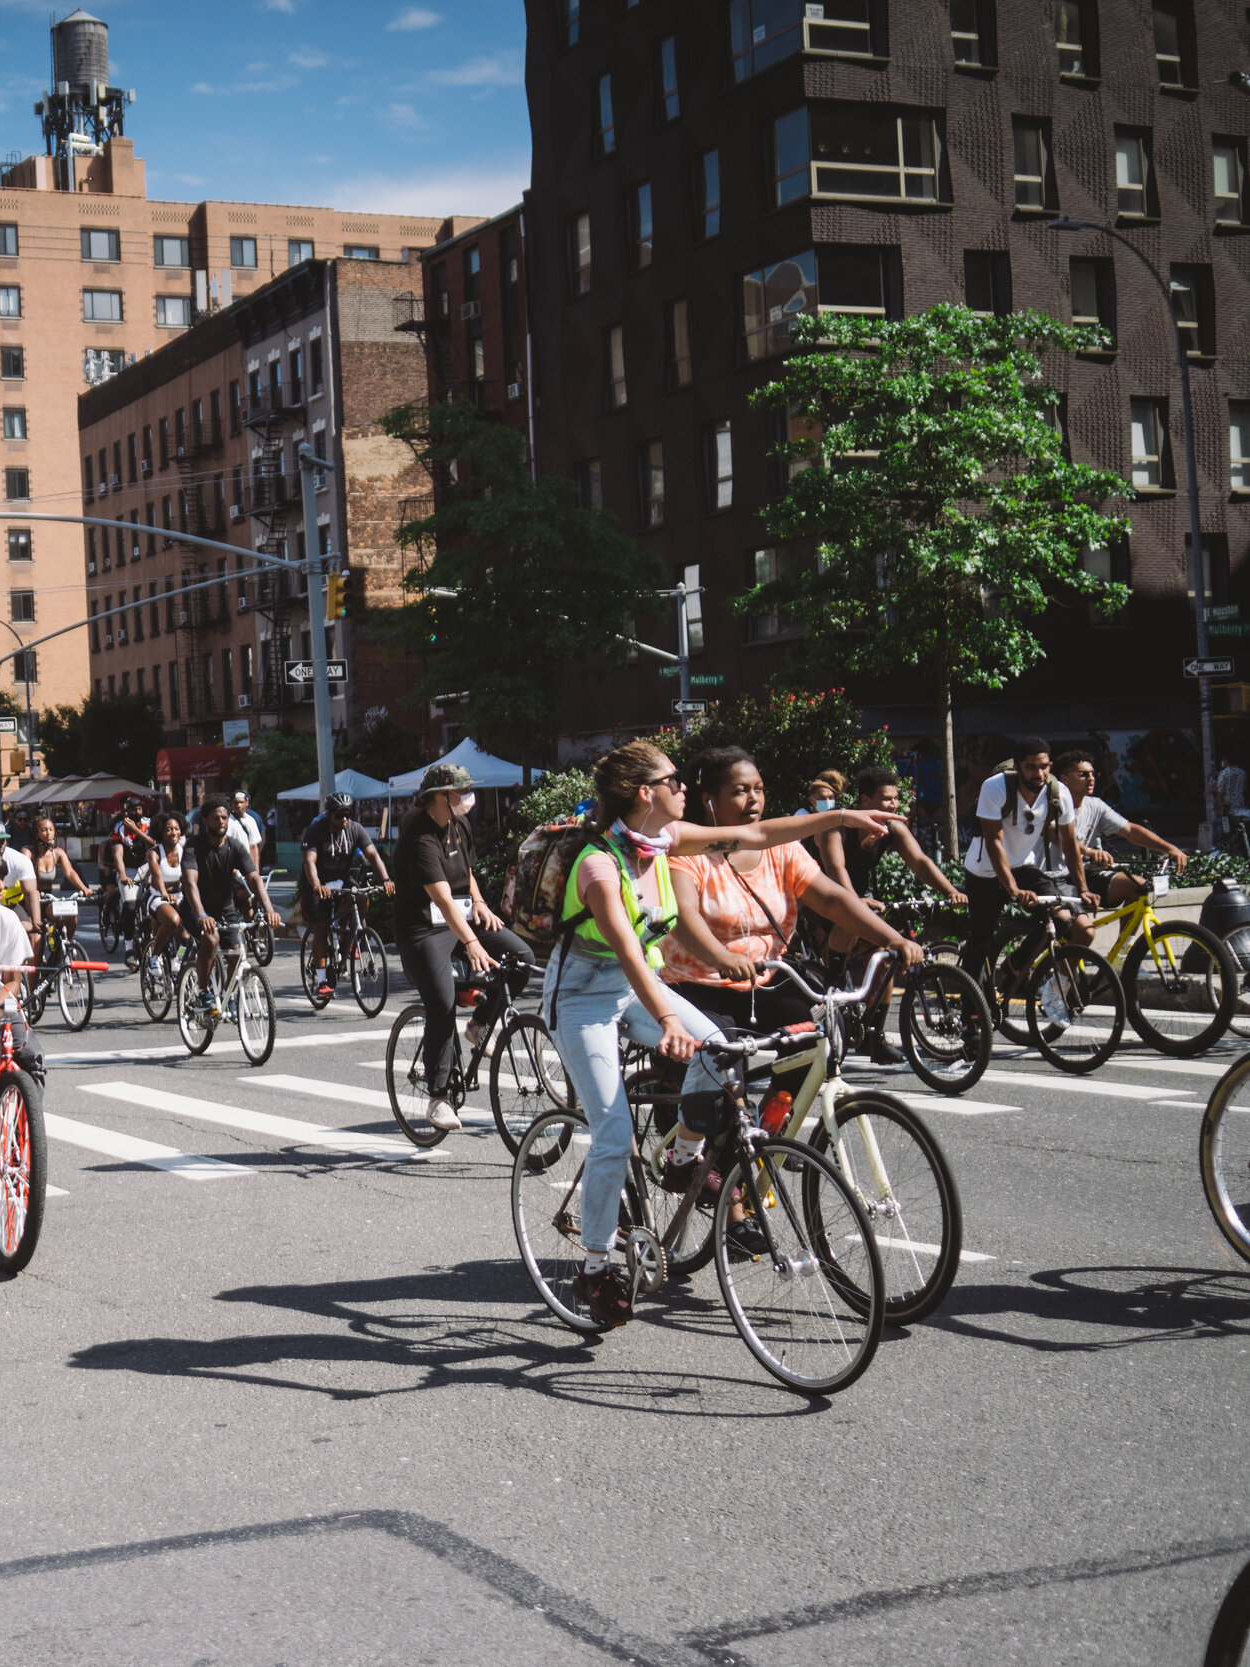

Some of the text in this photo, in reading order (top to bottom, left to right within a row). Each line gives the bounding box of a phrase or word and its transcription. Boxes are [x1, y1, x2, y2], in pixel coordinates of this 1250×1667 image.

[294, 667, 313, 677] ONE
[1190, 661, 1230, 672] ONE WAY
[691, 674, 718, 685] Mulberry
